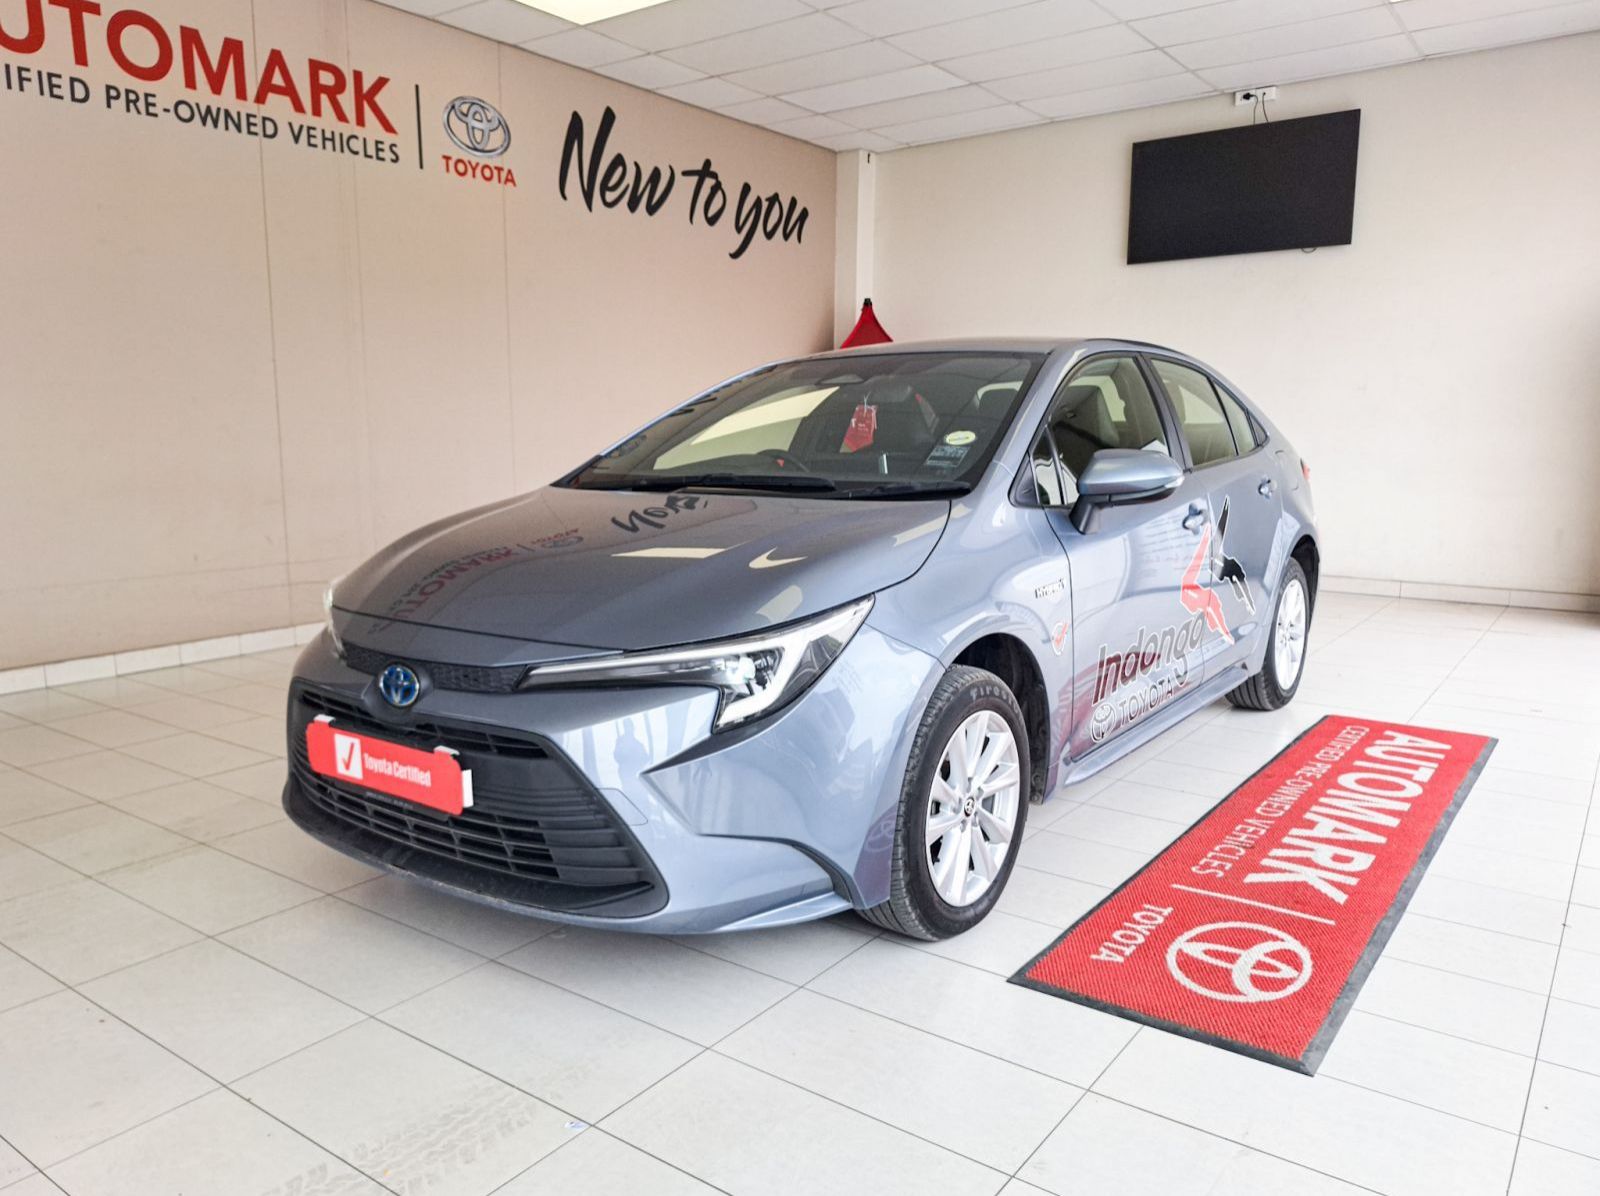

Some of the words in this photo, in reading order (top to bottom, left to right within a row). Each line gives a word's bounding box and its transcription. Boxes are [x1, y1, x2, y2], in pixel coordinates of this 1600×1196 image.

[0, 0, 398, 135] UTOMARK
[4, 63, 90, 104] IFIED
[104, 83, 278, 140] PRE-OWNED
[287, 121, 400, 164] VEHICLES
[441, 154, 517, 188] TOYOTA
[558, 105, 676, 217] New
[681, 157, 727, 228] to
[728, 181, 809, 260] you
[1091, 608, 1206, 688] Indongo
[1118, 675, 1174, 728] TOYOTA
[363, 752, 393, 777] Toyota
[393, 760, 432, 788] Certified
[1314, 725, 1370, 763] CERTIFIED
[1243, 730, 1452, 906] AUTOMARK
[1255, 760, 1332, 818] PRE-OWNED
[1190, 817, 1275, 879] VEHICLES
[1090, 903, 1174, 964] TOYOTA
